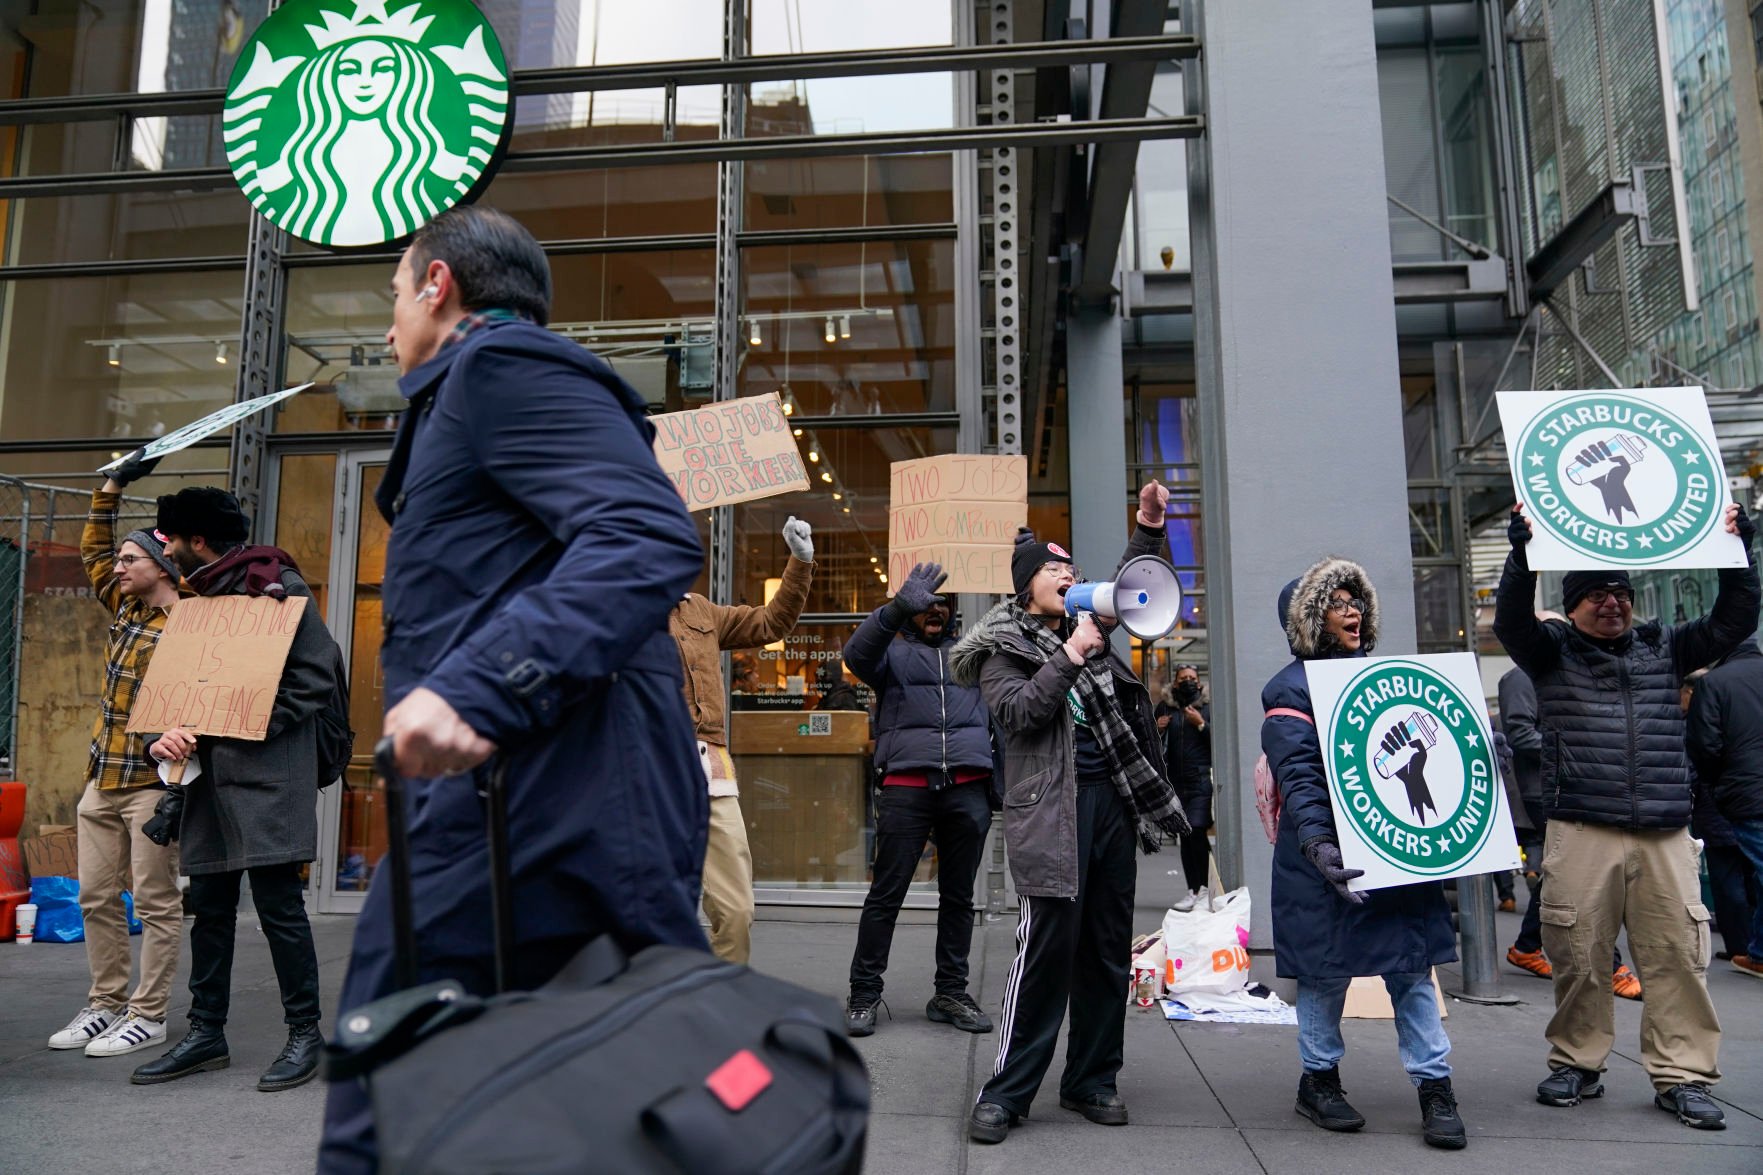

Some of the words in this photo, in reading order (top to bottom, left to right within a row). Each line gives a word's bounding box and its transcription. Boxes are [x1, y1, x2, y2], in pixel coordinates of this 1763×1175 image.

[654, 409, 723, 451] WO
[721, 400, 787, 439] JOBS
[1538, 404, 1683, 448] STARBUCKS
[682, 439, 754, 471] ONE
[893, 464, 940, 504] TWO
[948, 457, 1022, 496] JOBS
[890, 507, 929, 545] TWO
[1528, 472, 1629, 550] WORKERS
[1652, 472, 1709, 543] UNITED
[198, 641, 225, 675] IS
[758, 650, 782, 660] Get
[785, 649, 807, 660] the
[126, 681, 268, 735] DISGUSTING
[1347, 675, 1465, 732] STARBUCKS
[1342, 765, 1432, 857] WORKERS
[1449, 758, 1488, 844] UNITED
